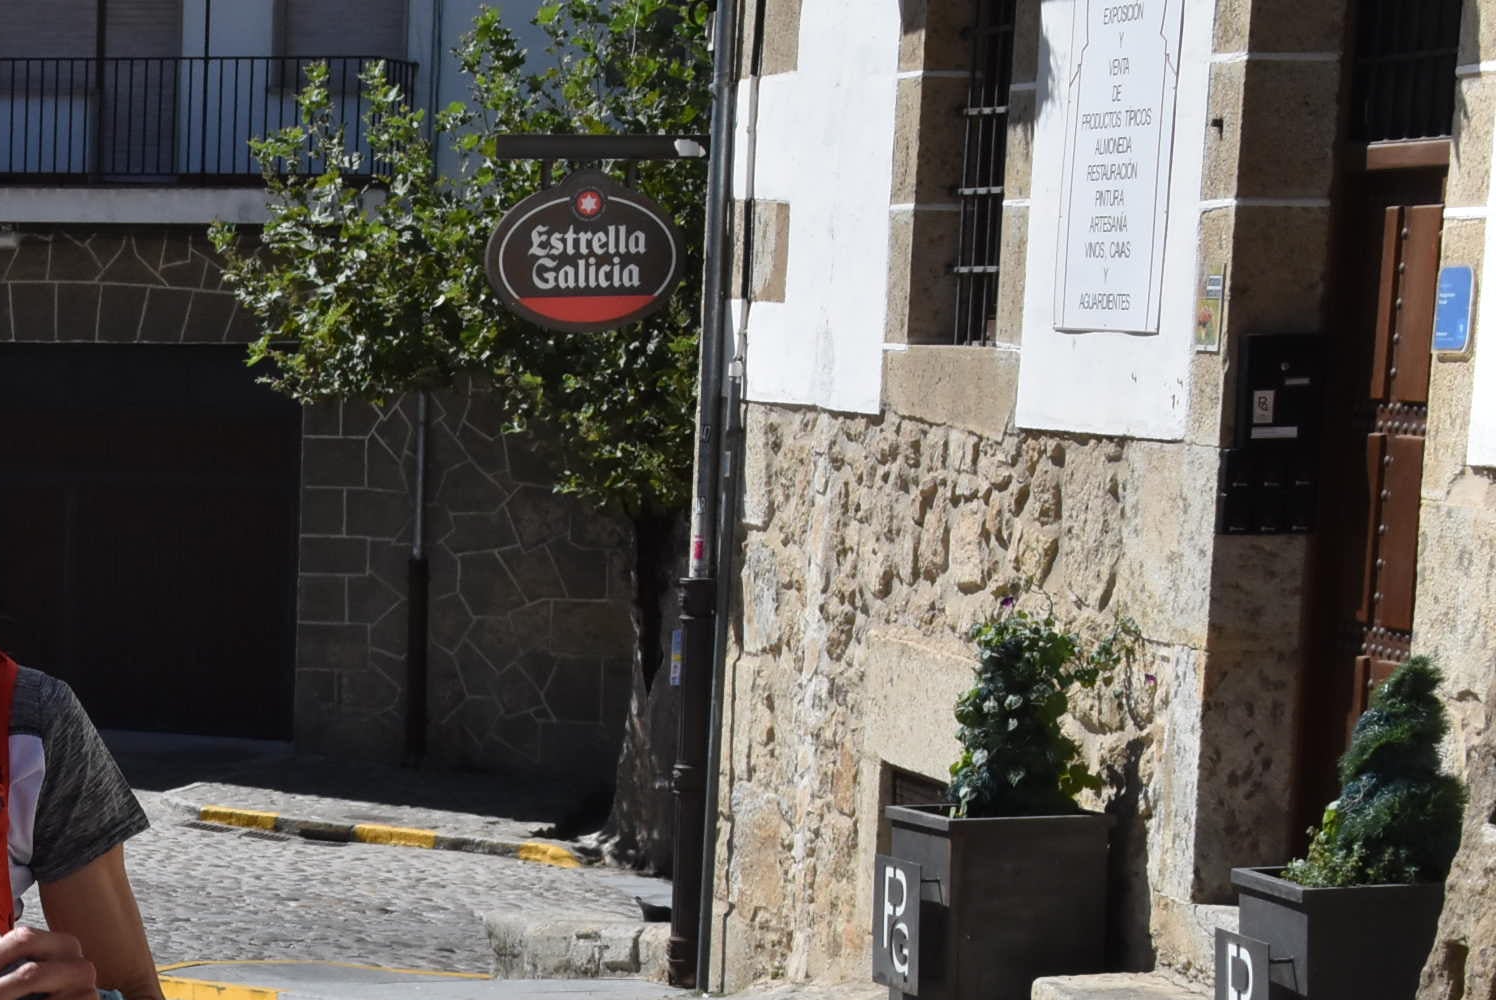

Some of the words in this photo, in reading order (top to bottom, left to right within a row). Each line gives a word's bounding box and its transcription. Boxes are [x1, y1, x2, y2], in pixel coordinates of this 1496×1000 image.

[1118, 31, 1125, 49] Y
[1109, 57, 1130, 76] VENTA
[1112, 84, 1122, 102] DE
[1081, 110, 1121, 130] PRODUCTOS
[1125, 106, 1152, 127] TÍPICOS
[1095, 136, 1132, 155] ALMONEDA
[1087, 161, 1137, 182] RESTAURACIÓN
[1095, 189, 1125, 207] PINTURA
[1089, 211, 1128, 233] ARTESANÍA
[528, 224, 646, 257] Estrella
[1109, 241, 1131, 259] CAVAS
[532, 257, 640, 290] Galicia
[1103, 266, 1110, 284] Y
[1079, 292, 1130, 311] AGUARDIENTES
